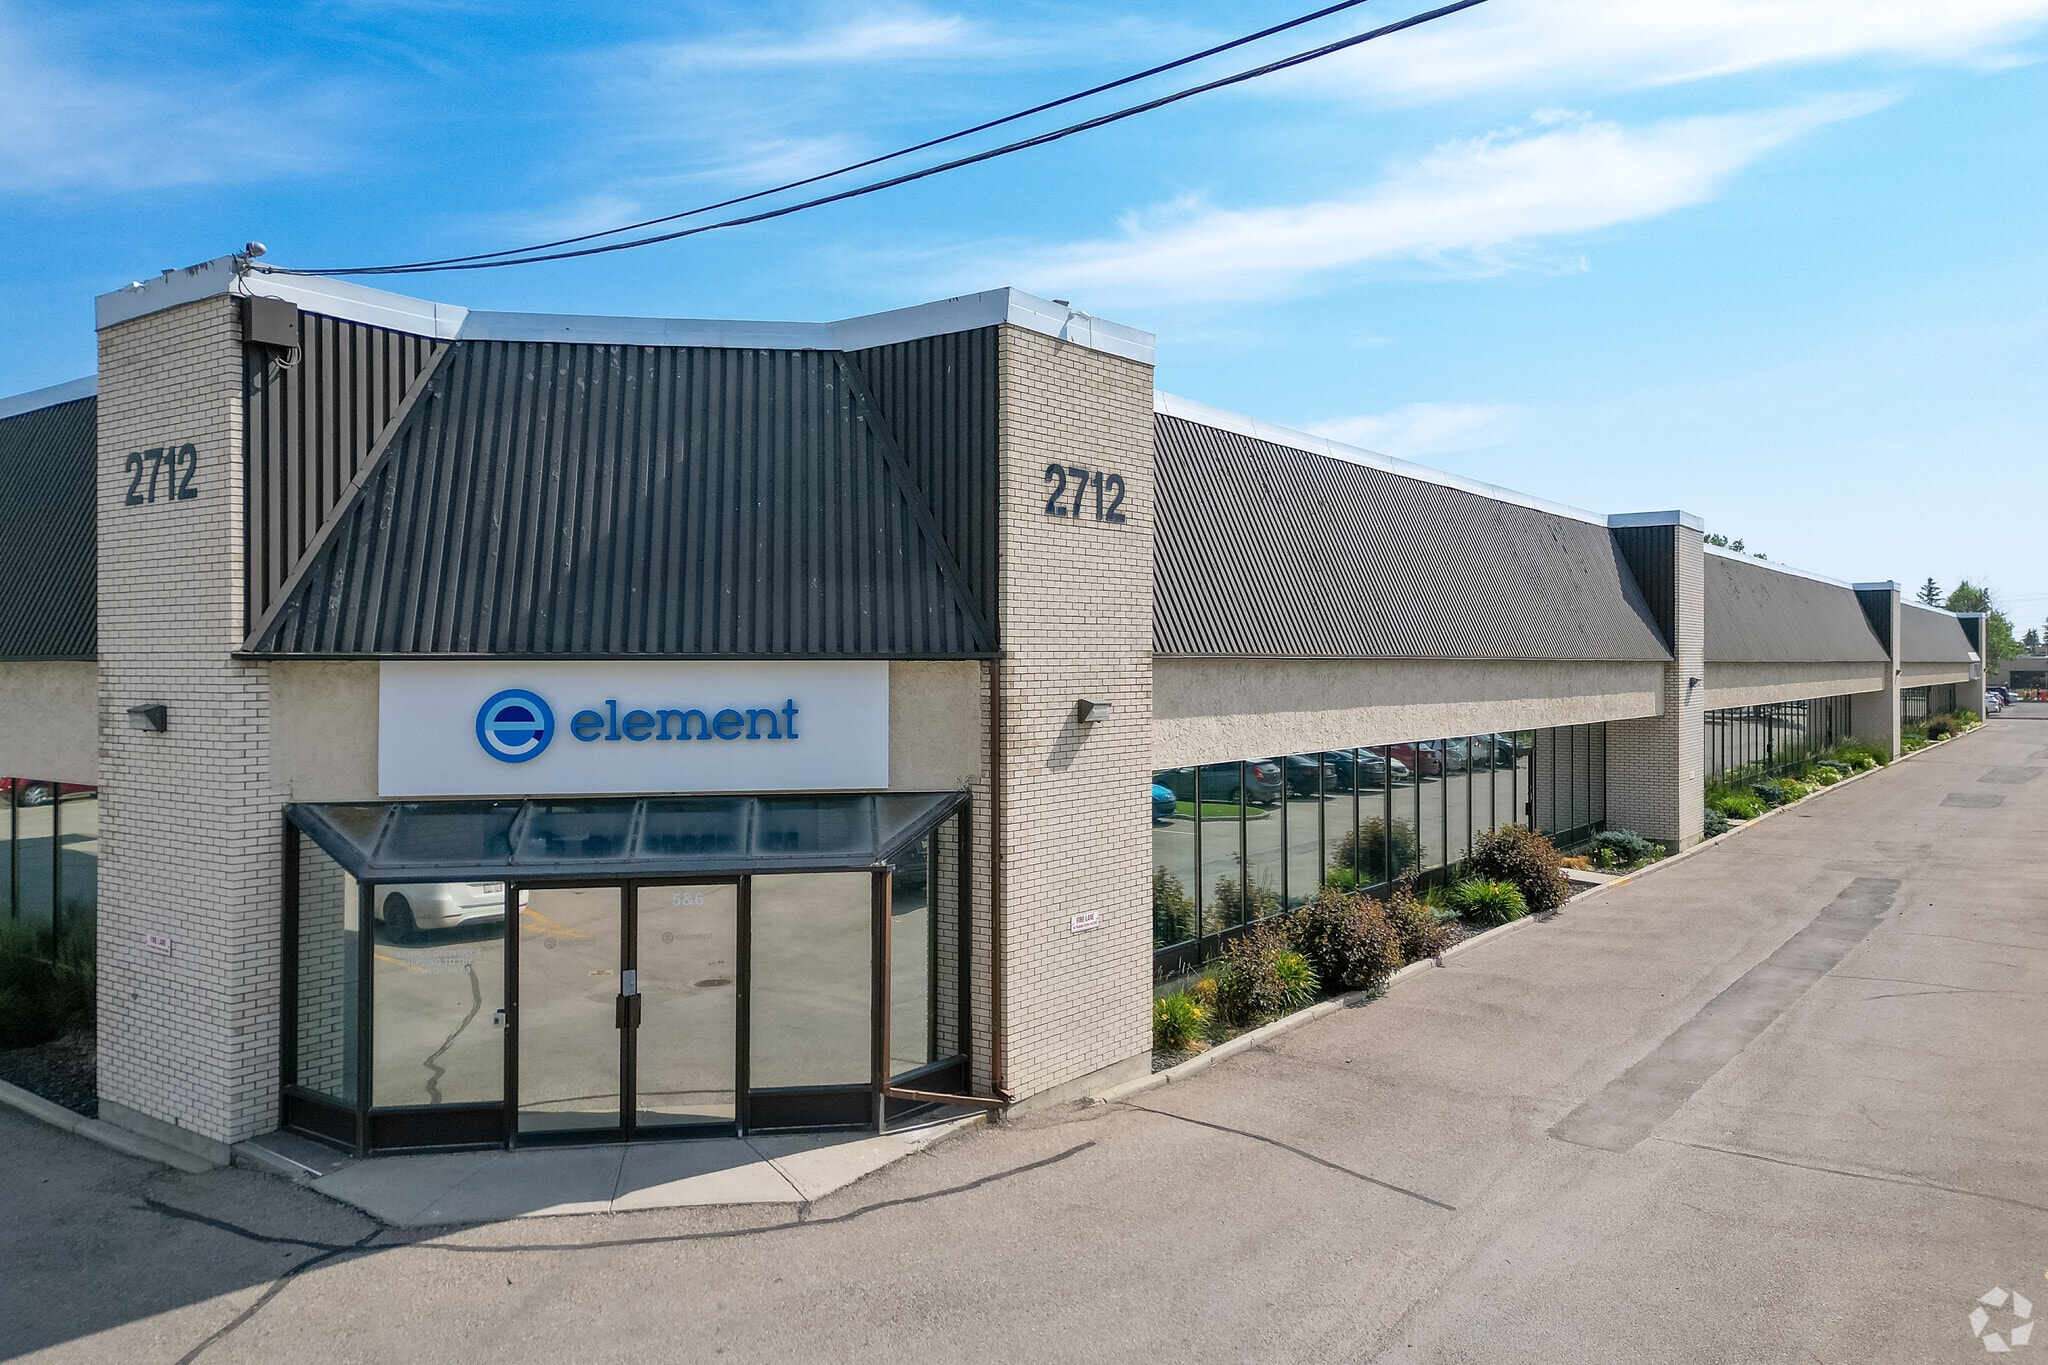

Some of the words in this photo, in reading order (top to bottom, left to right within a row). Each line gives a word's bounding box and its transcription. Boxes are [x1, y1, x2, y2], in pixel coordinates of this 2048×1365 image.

[125, 443, 197, 506] 2712
[1045, 464, 1125, 522] 2712
[570, 698, 799, 741] element
[673, 892, 704, 906] 5&6
